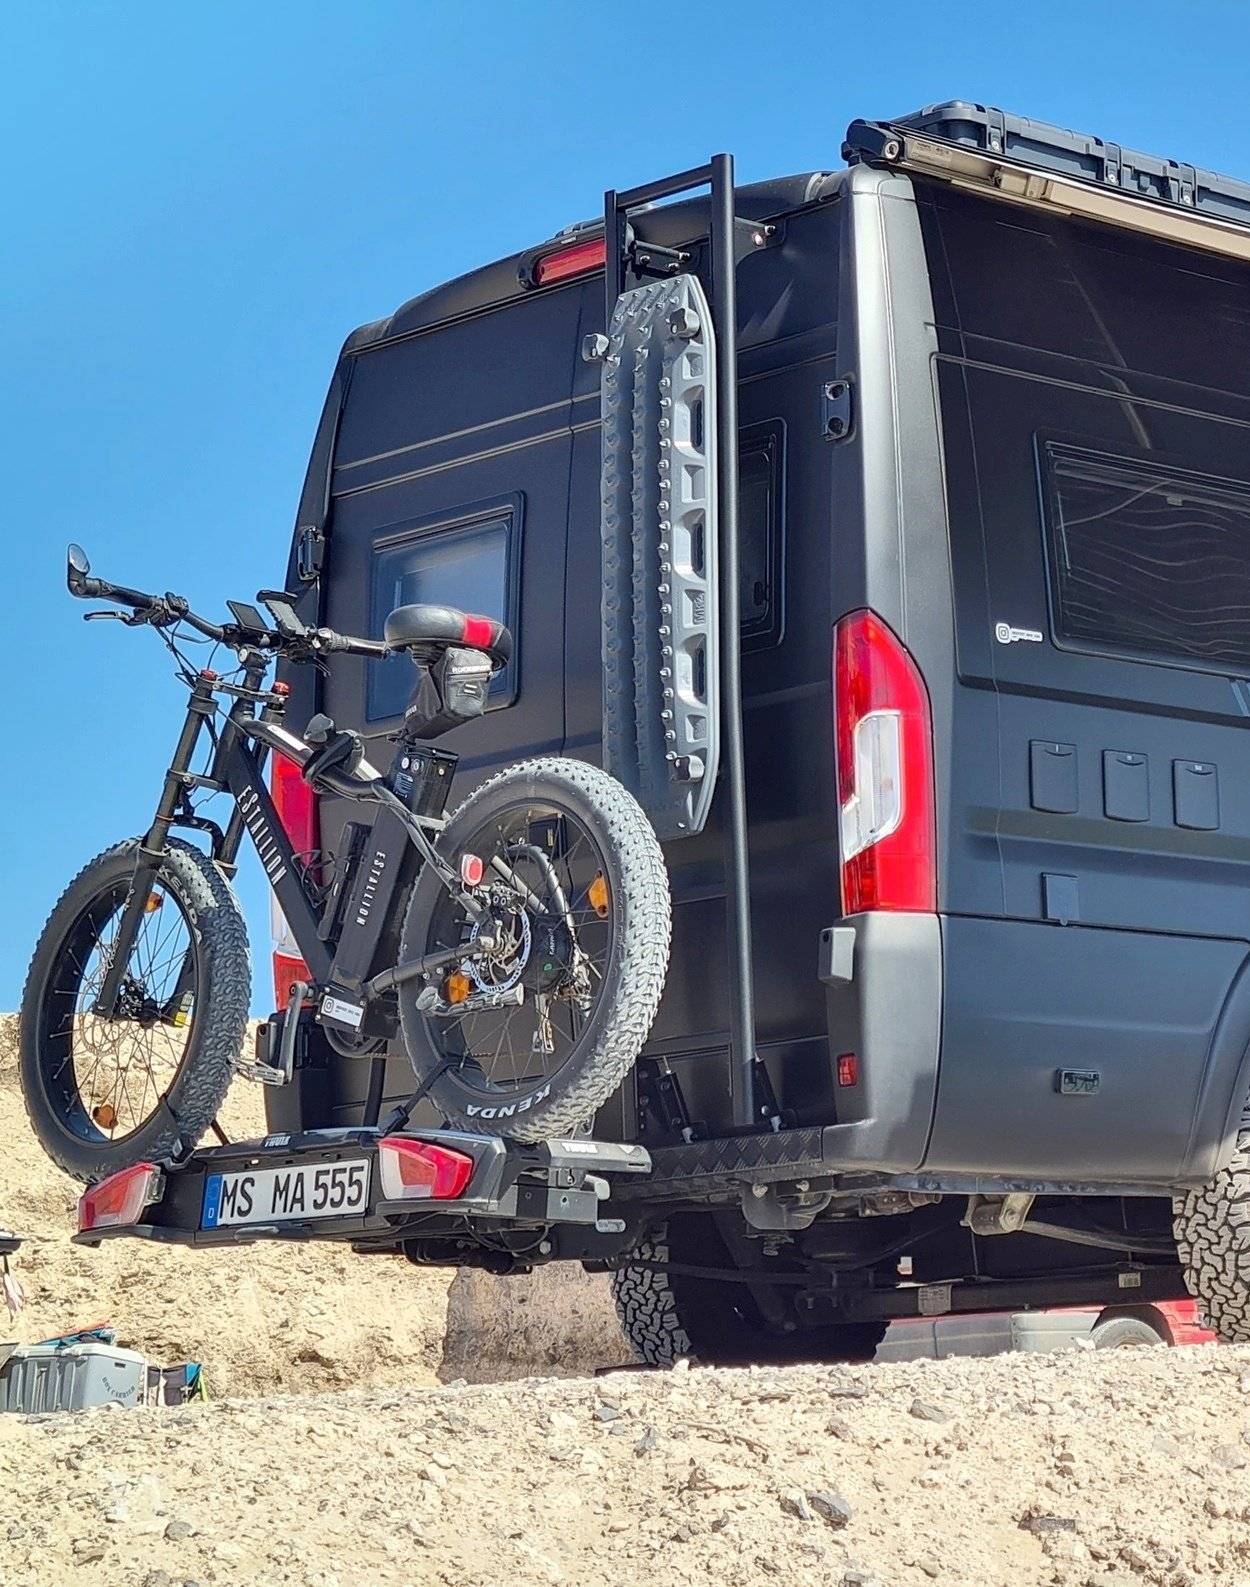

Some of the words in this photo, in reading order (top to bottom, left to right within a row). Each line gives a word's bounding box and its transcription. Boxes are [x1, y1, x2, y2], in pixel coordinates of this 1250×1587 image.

[237, 785, 287, 885] ESTALLION
[356, 851, 386, 925] ESTALLION
[466, 1083, 551, 1119] KENDA
[208, 1208, 215, 1219] D
[219, 1177, 255, 1219] MS
[271, 1172, 305, 1214] MA
[313, 1166, 365, 1210] 555
